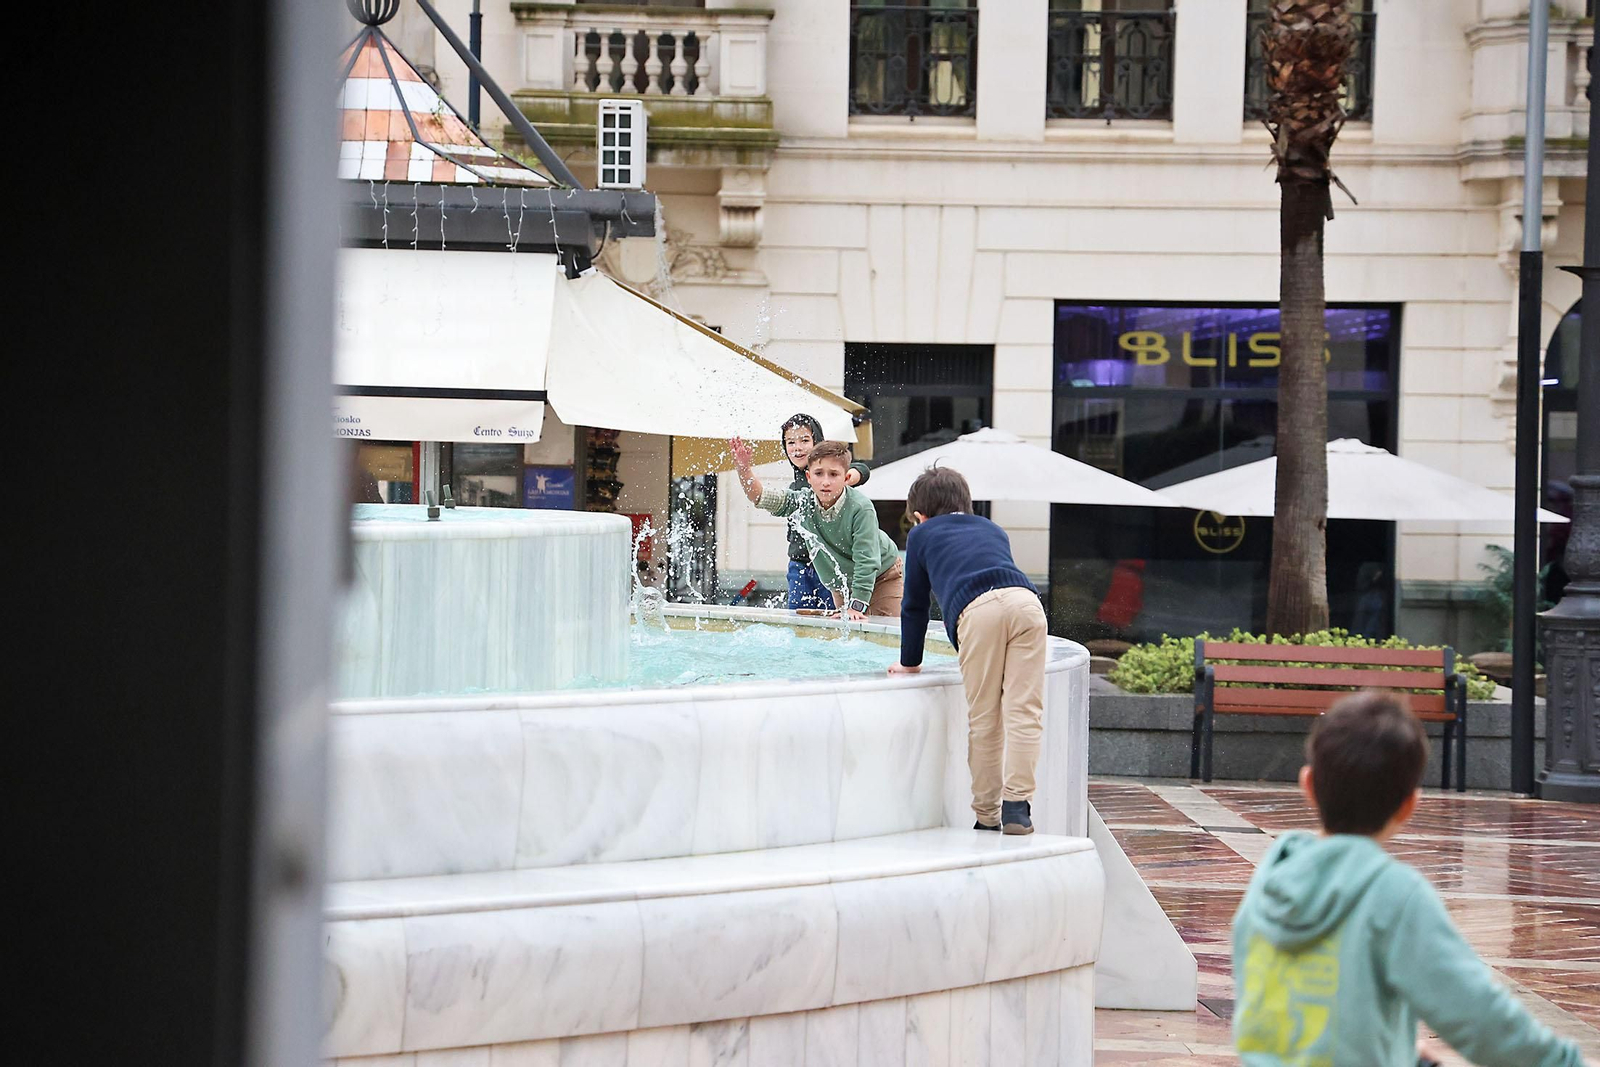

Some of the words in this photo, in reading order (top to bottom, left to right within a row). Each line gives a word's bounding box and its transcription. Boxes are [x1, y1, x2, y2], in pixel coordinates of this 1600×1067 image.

[1118, 331, 1331, 367] BLIS
[473, 426, 502, 437] Centro
[508, 426, 534, 439] Suizo
[1198, 526, 1242, 537] BLISS
